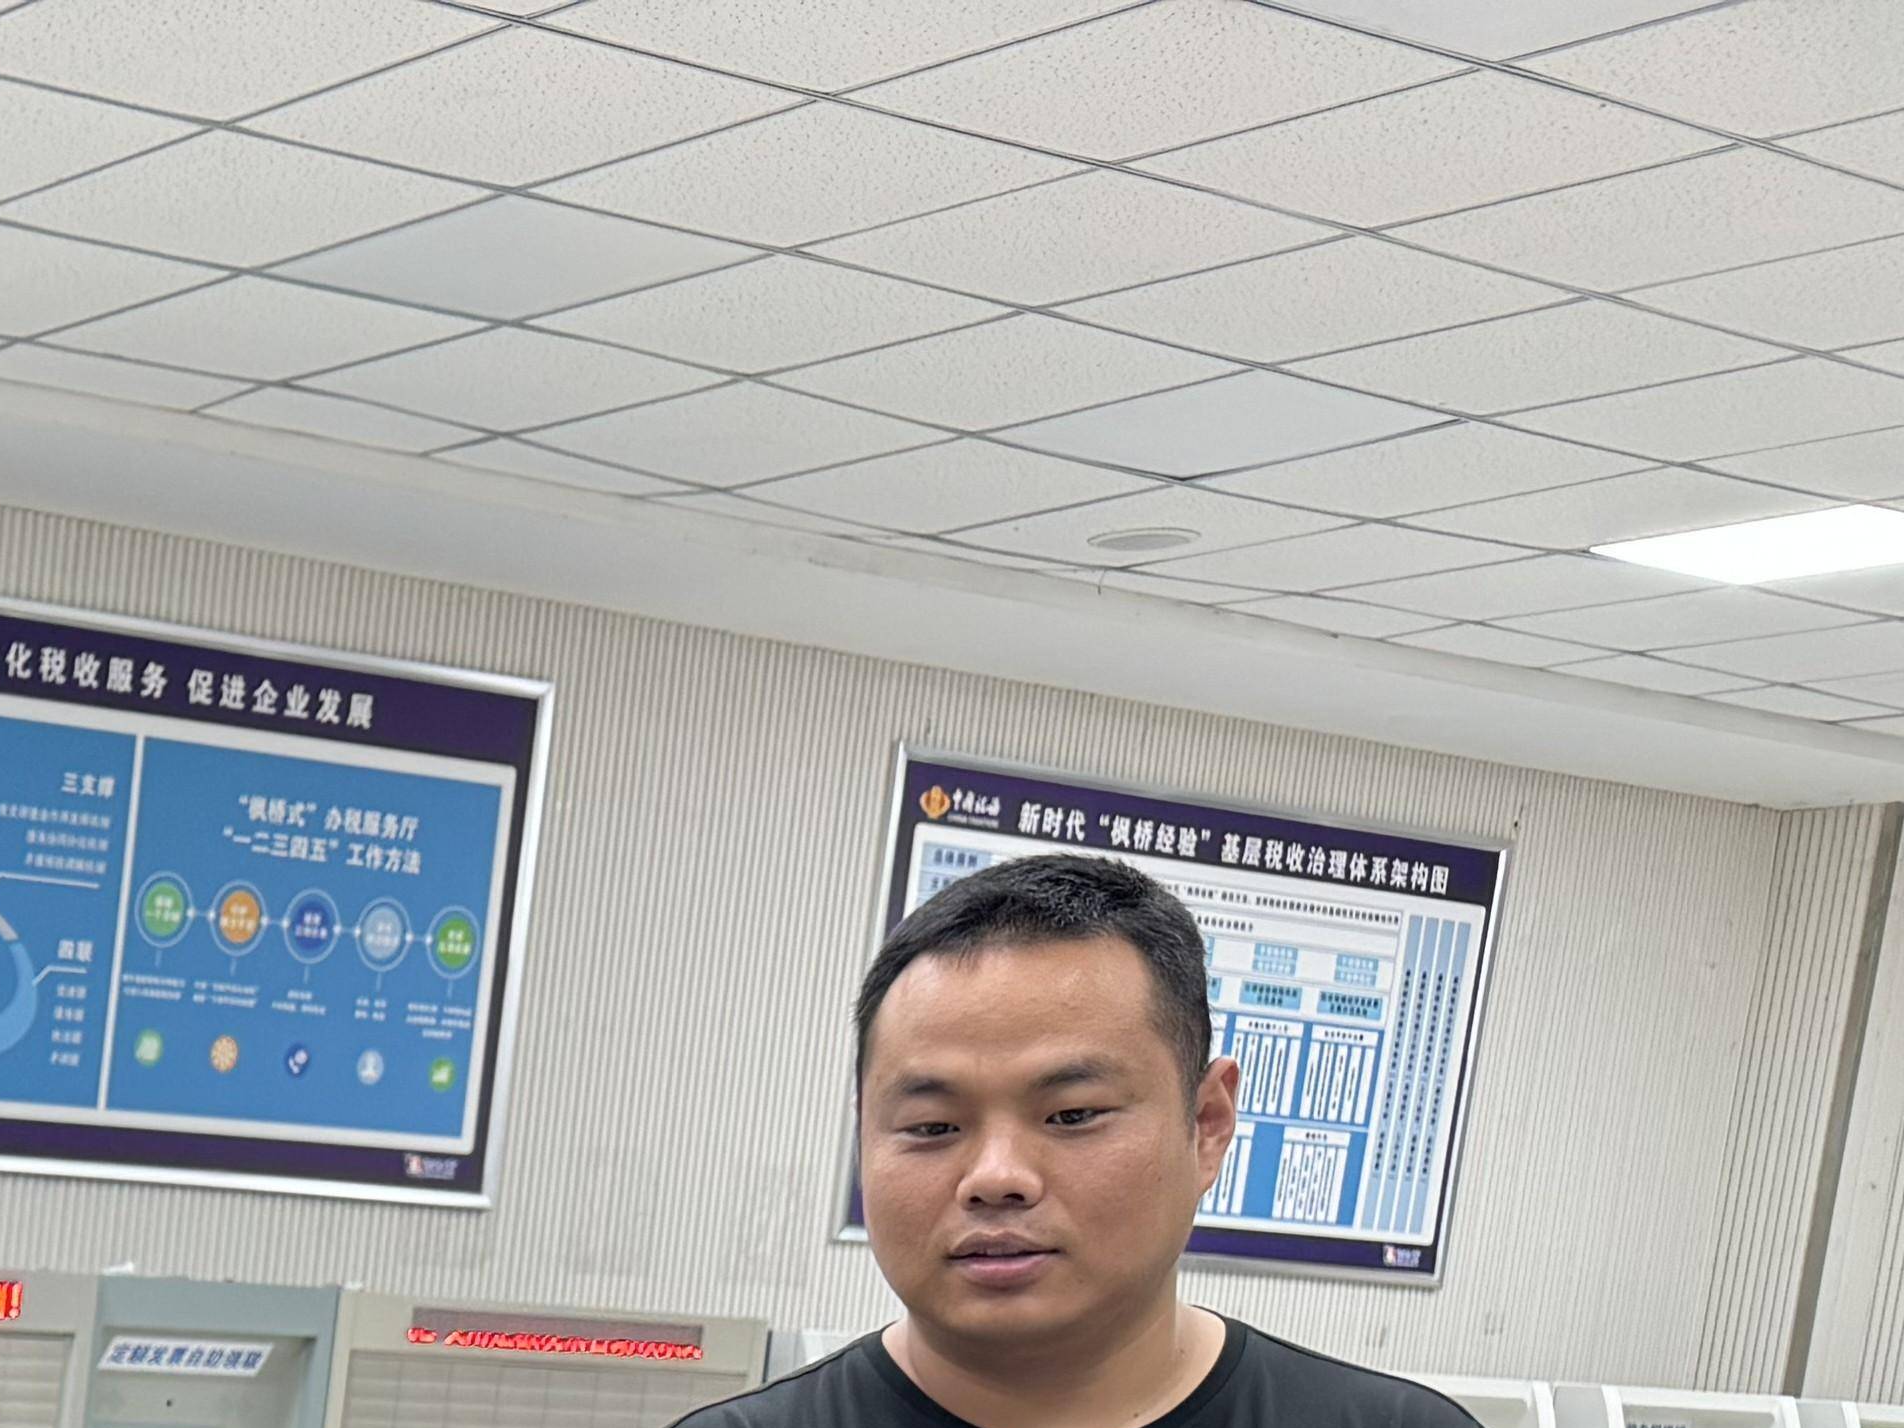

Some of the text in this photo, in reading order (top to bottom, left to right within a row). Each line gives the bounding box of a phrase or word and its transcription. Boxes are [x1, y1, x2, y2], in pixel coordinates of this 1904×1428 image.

[187, 669, 377, 730] 促进企业发展
[61, 771, 116, 799] 三支撑
[1017, 801, 1450, 895] 新时代“枫桥经验”基层税收治理体系架构图
